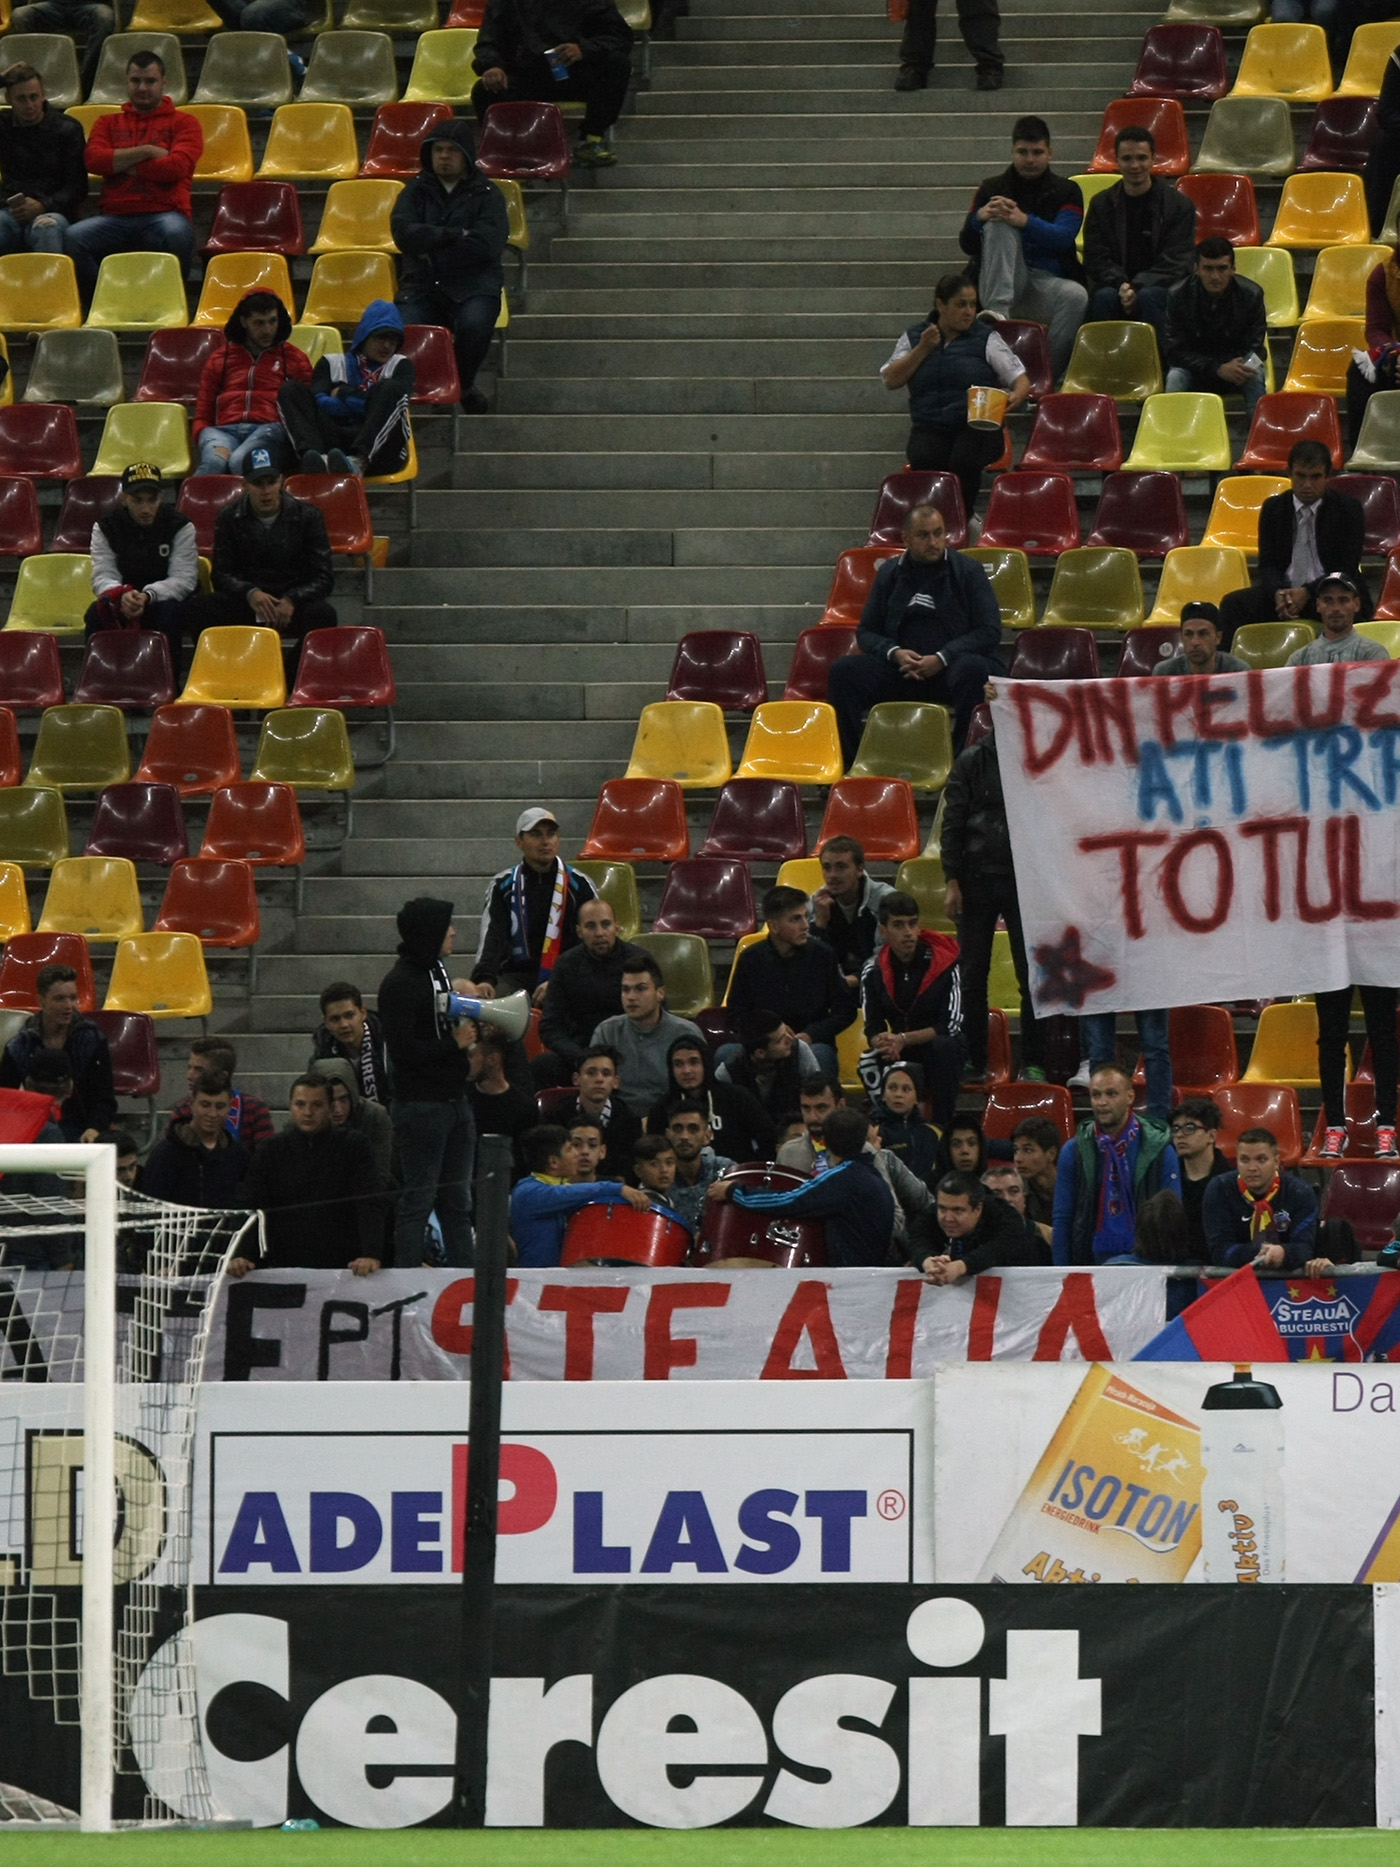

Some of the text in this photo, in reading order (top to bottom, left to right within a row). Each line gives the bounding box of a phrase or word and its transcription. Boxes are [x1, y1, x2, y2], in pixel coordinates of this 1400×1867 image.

[1008, 678, 1138, 776] DIN
[1277, 1302, 1351, 1322] STEAUA
[1279, 1322, 1349, 1333] BUCURESTI
[218, 1443, 868, 1575] ADEPLAST
[1041, 1502, 1101, 1534] ENERGIEDRINK
[1048, 1459, 1200, 1545] ISOTON
[130, 1597, 1103, 1829] Ceresit
